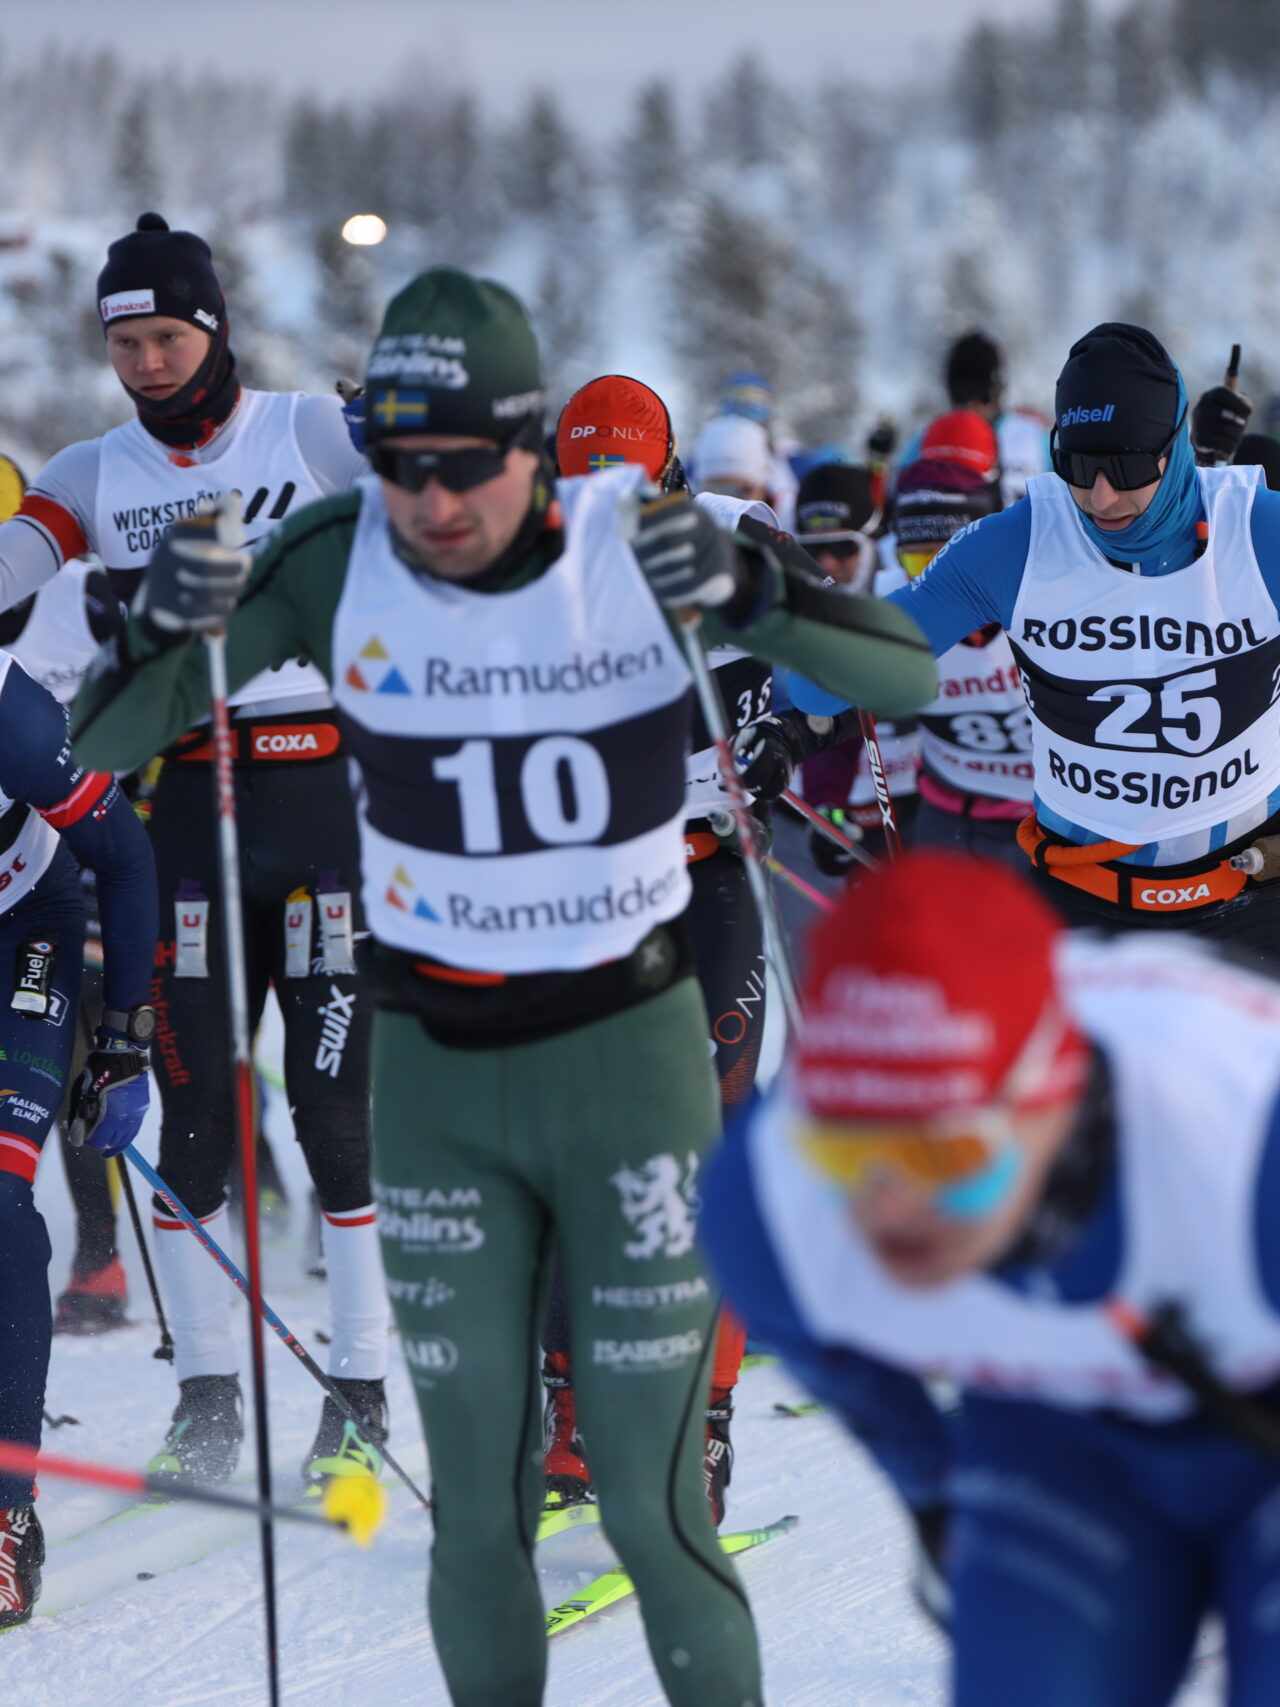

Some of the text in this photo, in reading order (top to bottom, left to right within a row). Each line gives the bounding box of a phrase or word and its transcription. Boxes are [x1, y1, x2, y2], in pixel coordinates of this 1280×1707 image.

[1061, 403, 1115, 427] ahlsell
[1022, 614, 1268, 657] ROSSIGNOL
[424, 642, 665, 698] Ramudden
[1086, 668, 1222, 755] 25
[255, 733, 319, 753] COXA
[432, 735, 611, 856] 10
[1048, 747, 1260, 810] ROSSIGNOL
[447, 866, 680, 933] Ramudden
[1140, 883, 1210, 904] COXA
[20, 953, 46, 990] Fuel
